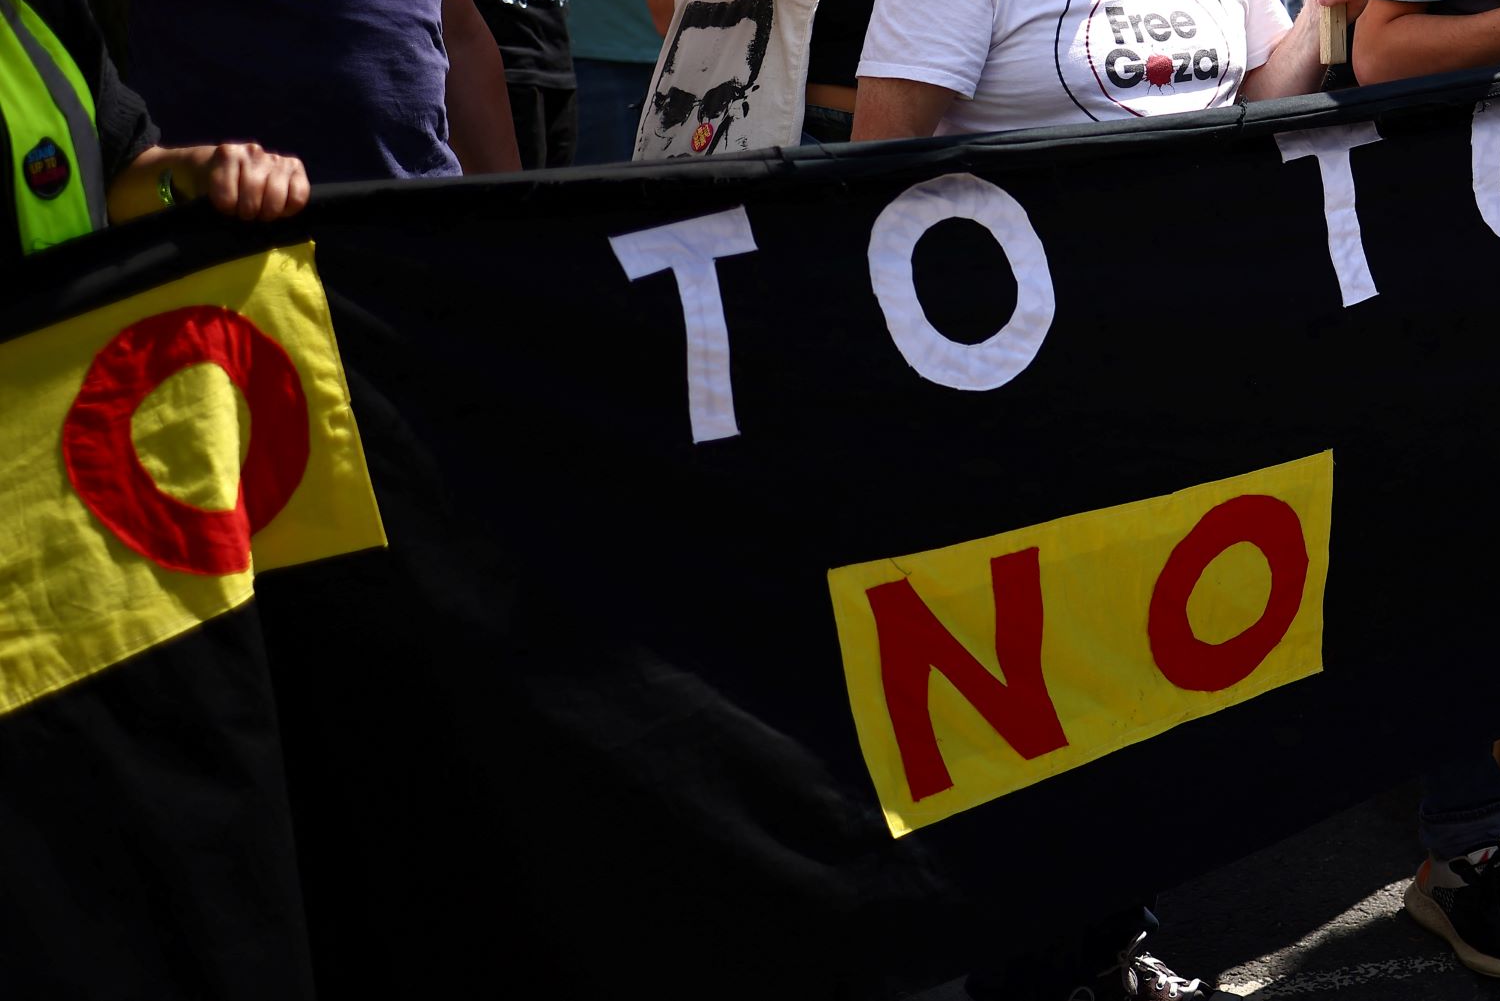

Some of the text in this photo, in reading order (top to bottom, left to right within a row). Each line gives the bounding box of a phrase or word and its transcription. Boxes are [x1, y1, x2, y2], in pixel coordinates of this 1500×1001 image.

[1105, 6, 1197, 45] Free
[608, 171, 1056, 445] TO
[865, 493, 1310, 803] NO
